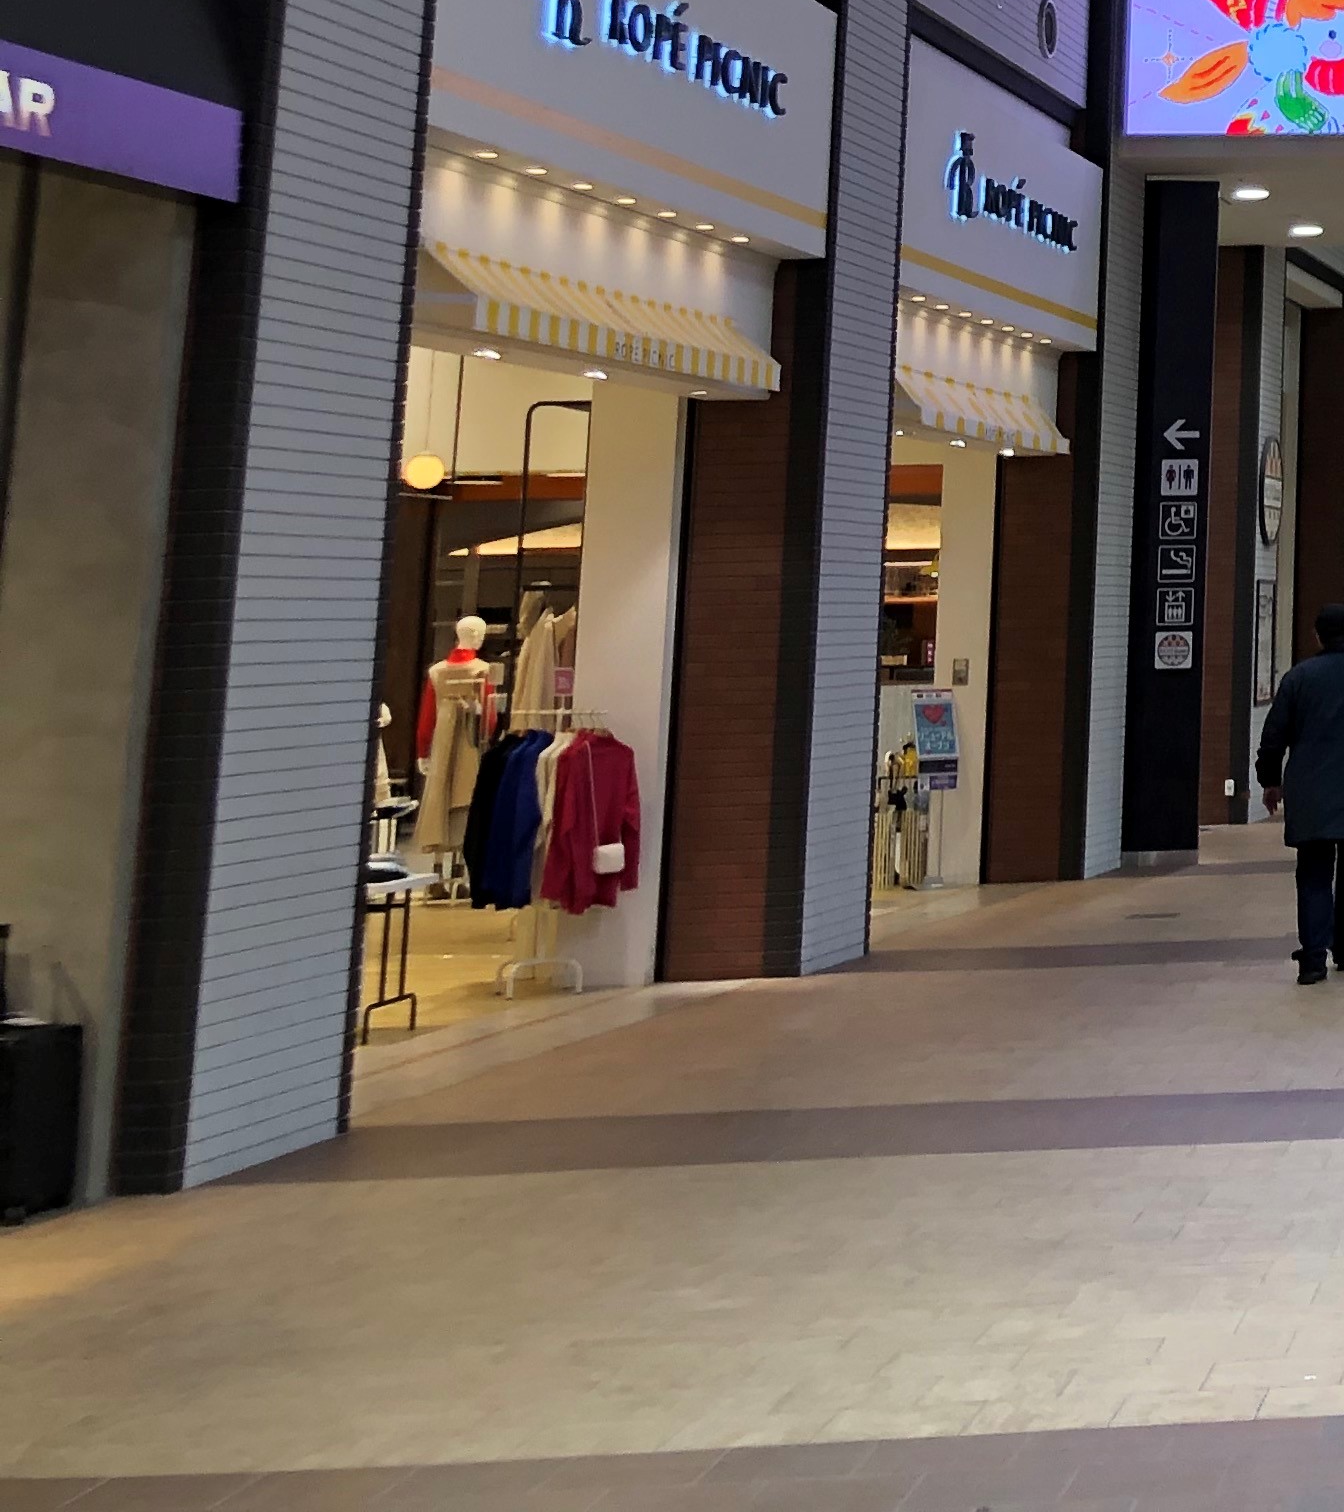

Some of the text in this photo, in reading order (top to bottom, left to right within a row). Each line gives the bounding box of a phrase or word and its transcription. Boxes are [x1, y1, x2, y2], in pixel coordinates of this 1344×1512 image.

[691, 31, 789, 117] PICNIC
[979, 175, 1079, 253] ROPÉ PICNIC
